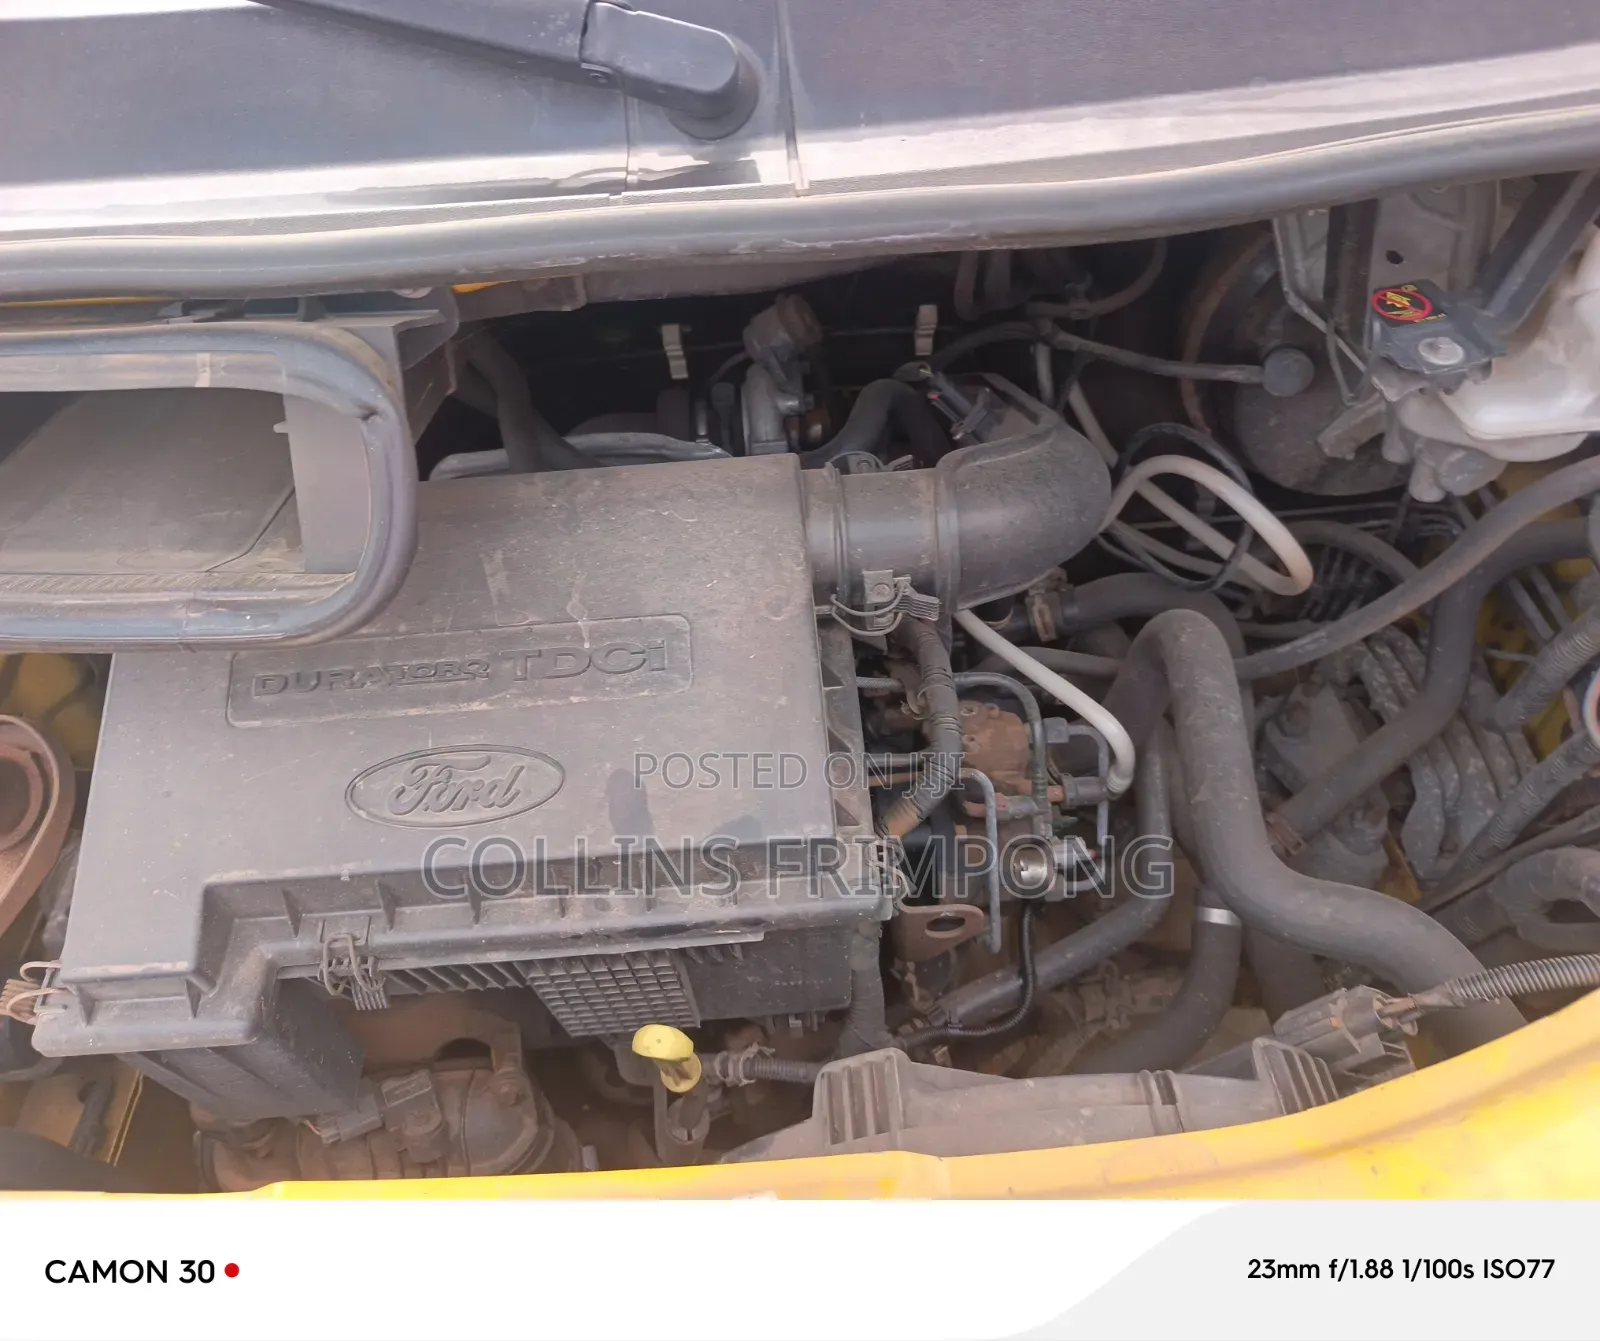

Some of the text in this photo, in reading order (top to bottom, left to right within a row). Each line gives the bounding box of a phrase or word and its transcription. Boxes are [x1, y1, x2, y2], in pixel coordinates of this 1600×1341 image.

[253, 639, 667, 698] DURATORQ TDCi
[389, 755, 526, 815] Ford
